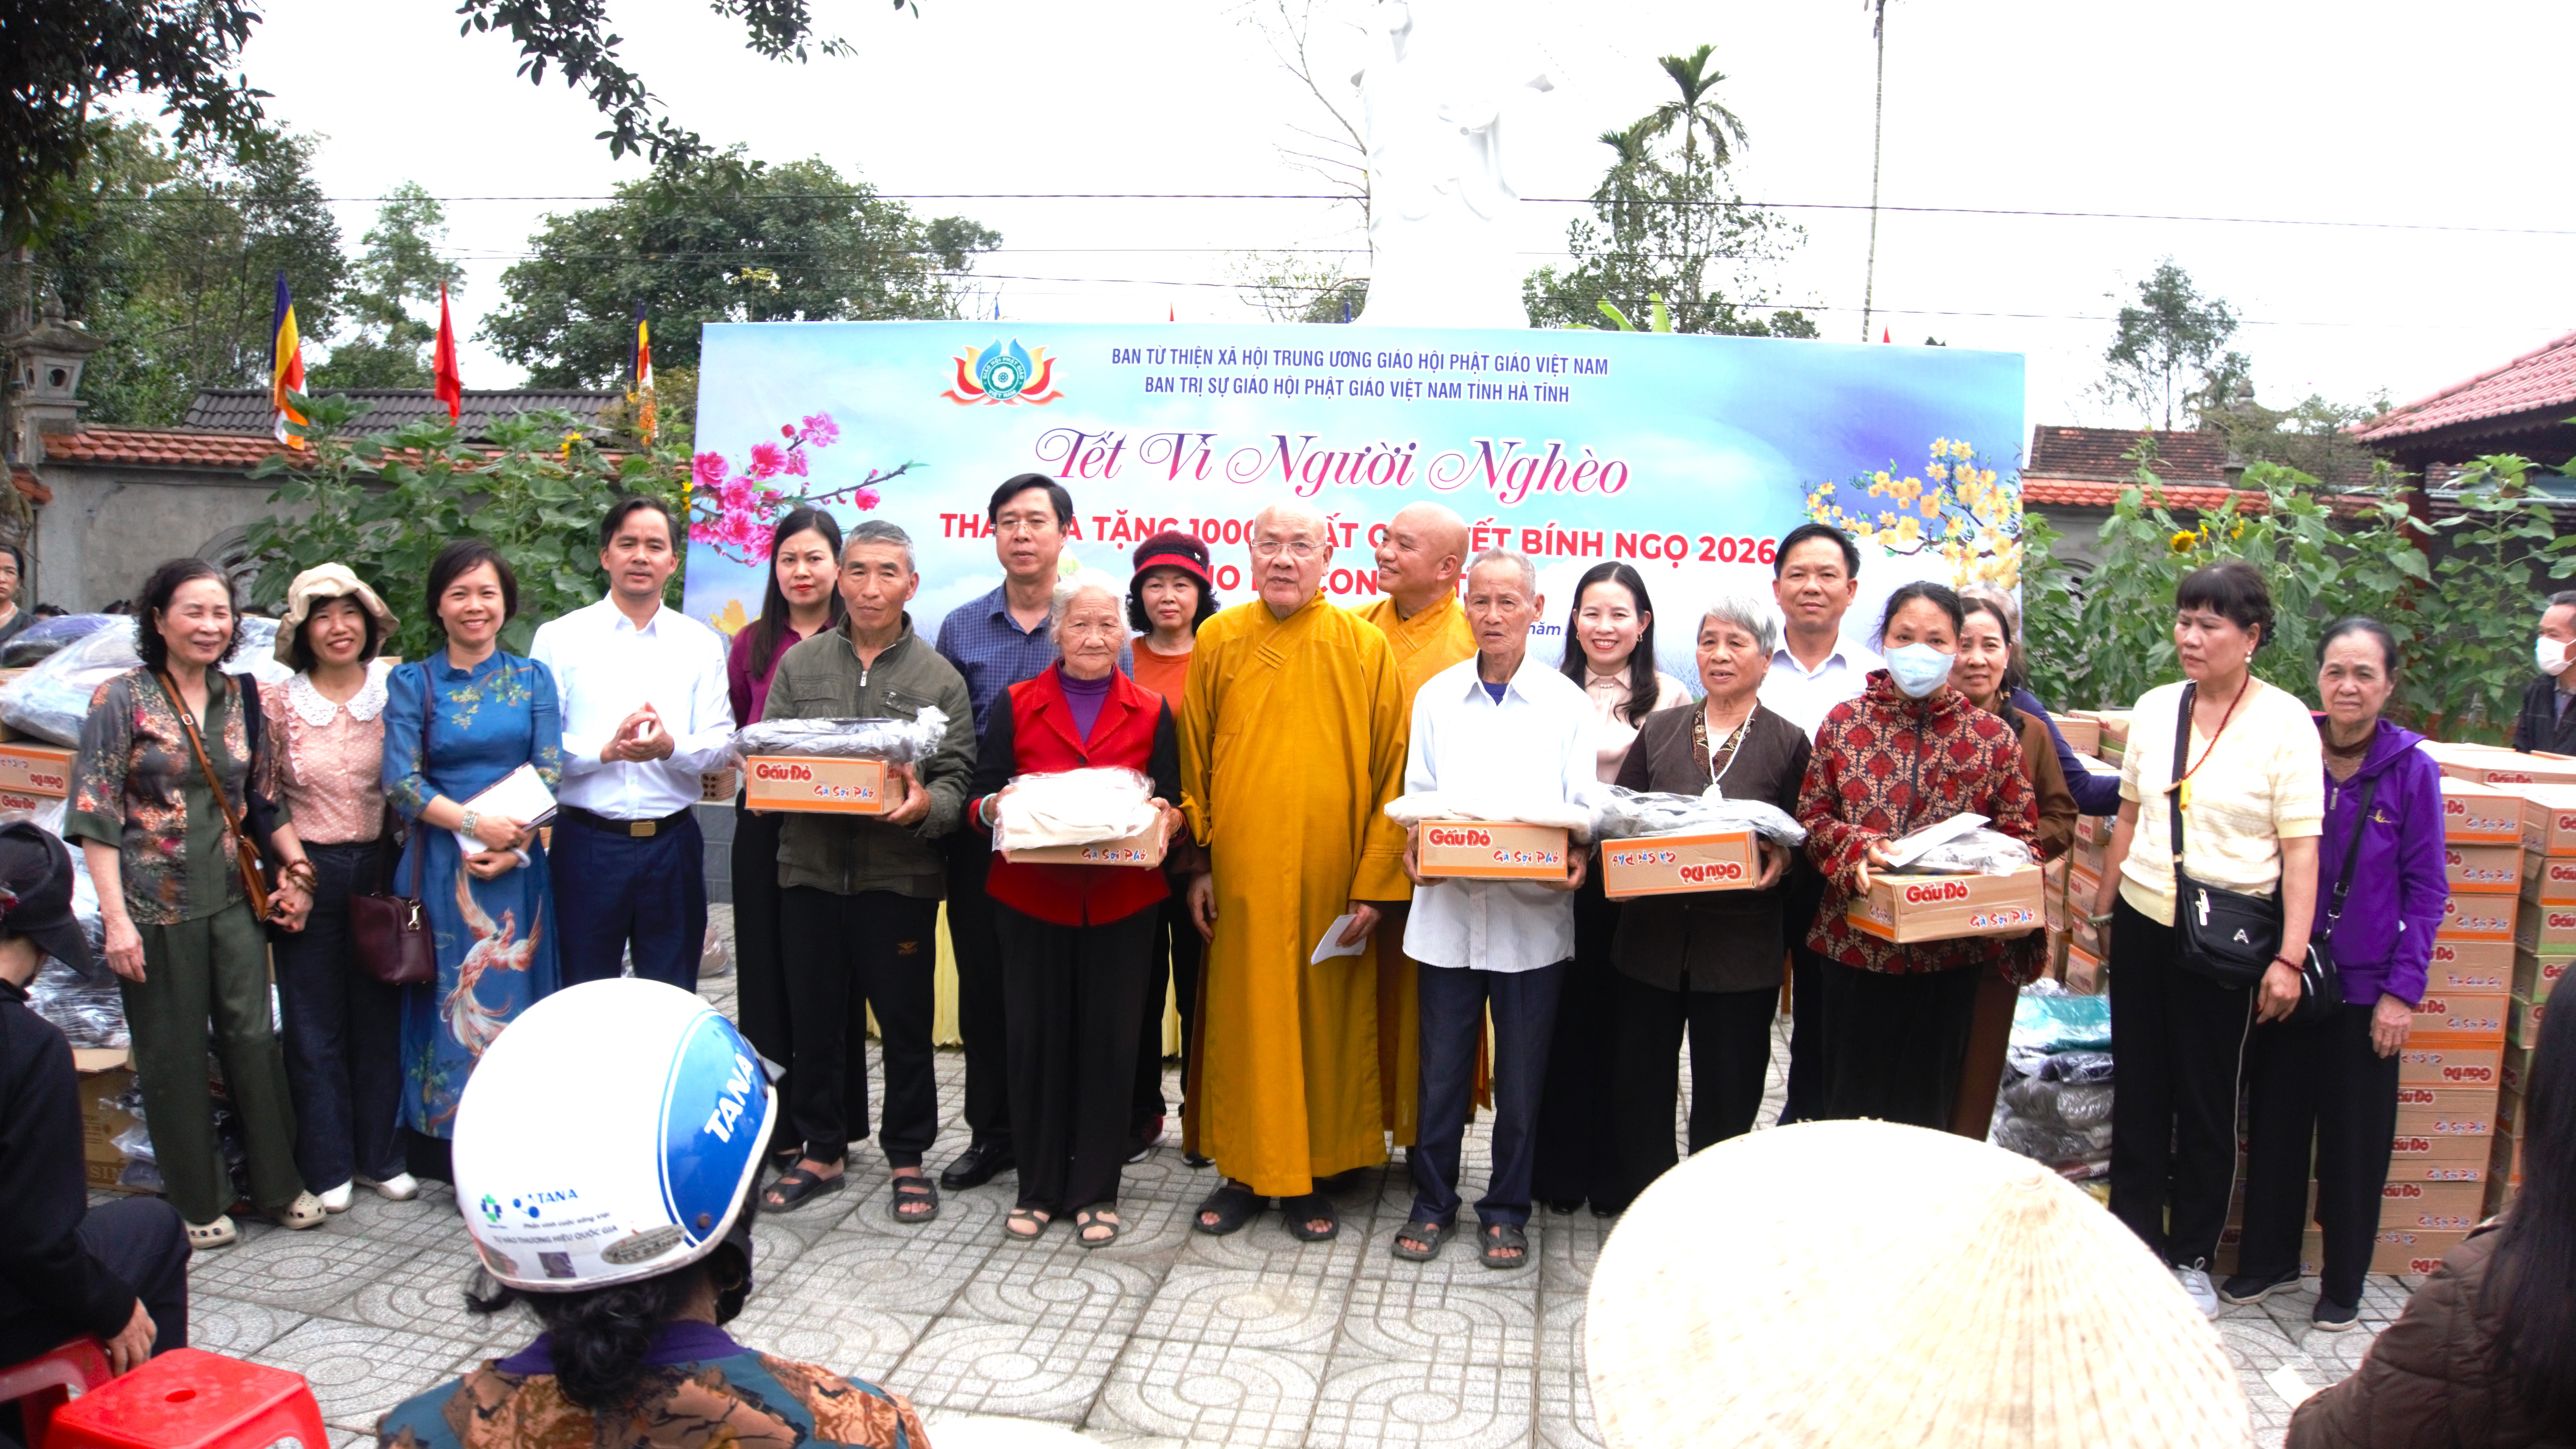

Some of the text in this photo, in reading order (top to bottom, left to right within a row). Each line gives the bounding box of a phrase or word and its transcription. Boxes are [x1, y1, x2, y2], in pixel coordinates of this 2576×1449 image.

[1112, 345, 1608, 377] BAN TỪ THIỆN XÃ HỘI TRUNG ƯƠNG GIÁO HỘI PHẬT GIÁO VIỆT NAM
[1145, 374, 1569, 402] BAN TRỊ SỰ GIÁO HỘI PHẬT GIÁO VIỆT NAM TỈNH HÀ TĨNH
[1036, 428, 1628, 504] Tết Vì Người Nghèo
[1522, 523, 1603, 557] BÍNH
[1615, 533, 1688, 569] NGỌ
[1699, 535, 1776, 564] 2026
[814, 785, 874, 799] Gà Sợi Phở
[1082, 848, 1146, 862] Gà Sợi Phở
[1493, 850, 1558, 865] Gà Sợi Phở
[704, 1053, 754, 1143] TANA
[537, 1188, 578, 1204] TANA
